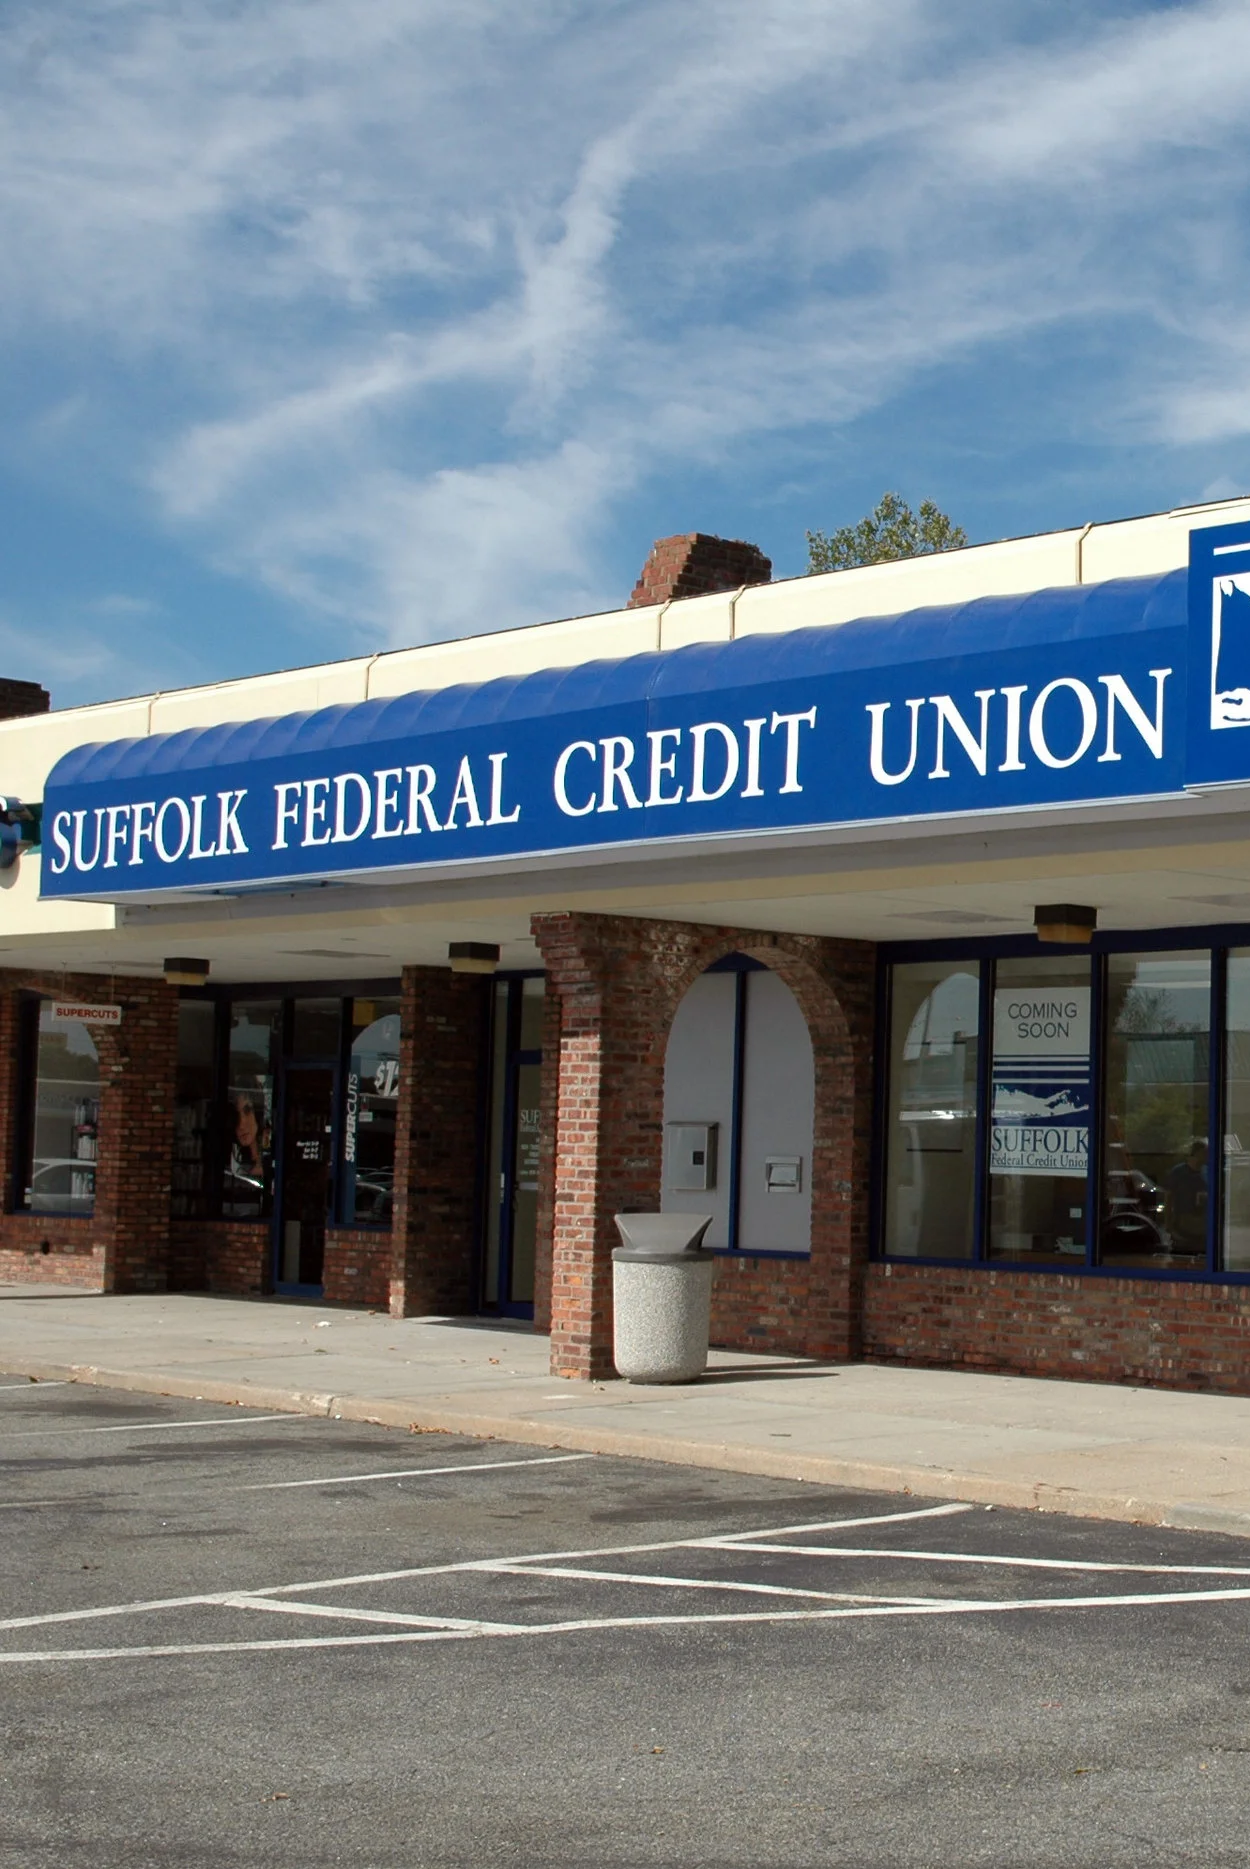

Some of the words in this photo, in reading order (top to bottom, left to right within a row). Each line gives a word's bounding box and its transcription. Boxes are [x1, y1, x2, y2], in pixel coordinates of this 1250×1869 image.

[51, 790, 249, 874] SUFFOLK
[271, 752, 521, 851] FEDERAL
[553, 705, 818, 817] CREDIT
[866, 668, 1173, 786] UNION
[56, 1007, 119, 1019] SUPERCUTS
[1007, 1002, 1078, 1020] COMING
[1017, 1021, 1070, 1039] SOON
[345, 1073, 359, 1163] SUPERCUTS
[992, 1127, 1089, 1154] SUFFOLK
[992, 1153, 1024, 1165] Federal
[1026, 1154, 1057, 1167] Credit
